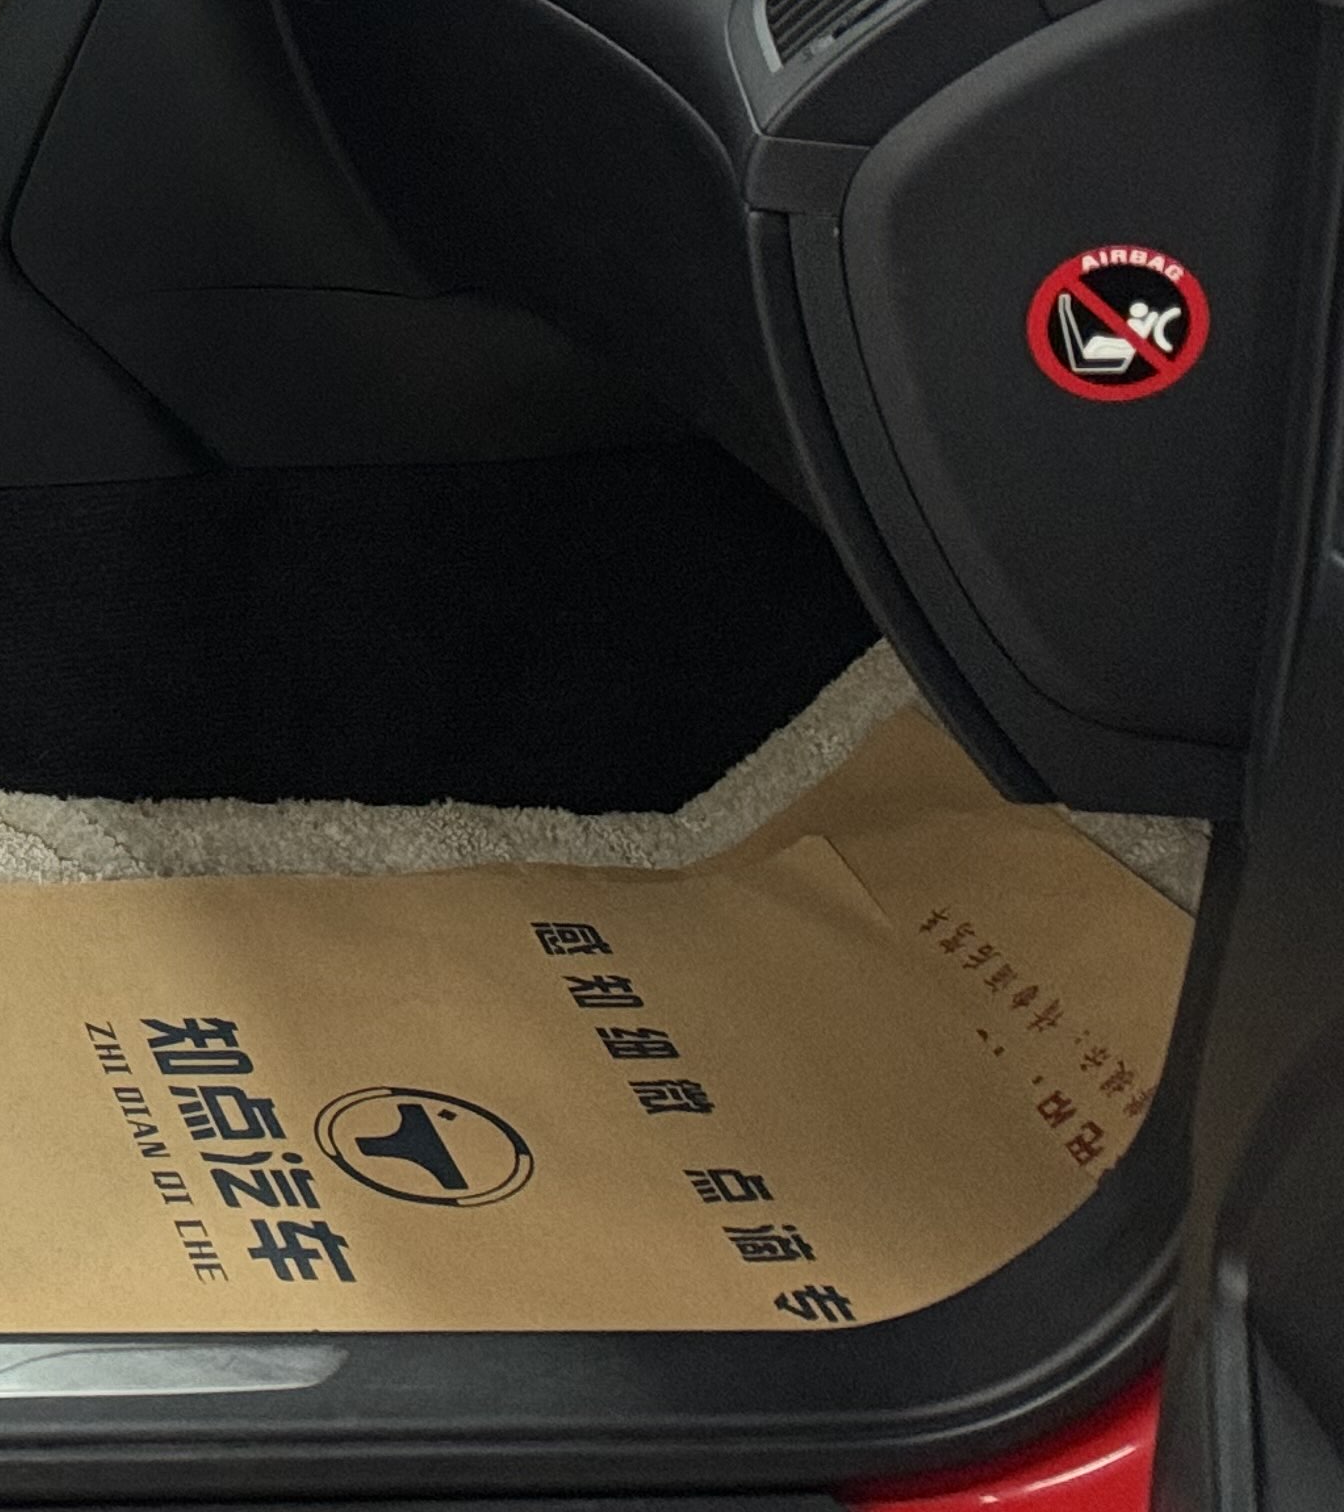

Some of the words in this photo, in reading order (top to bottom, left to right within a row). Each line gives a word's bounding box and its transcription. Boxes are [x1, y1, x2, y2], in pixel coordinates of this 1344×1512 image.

[1080, 248, 1186, 282] AIRBAG
[84, 1019, 134, 1077] ZHI
[113, 1085, 172, 1161] DIAN
[149, 1171, 193, 1205] QI
[174, 1218, 229, 1284] CHE
[139, 1017, 358, 1285] 知点汽车
[528, 920, 715, 1116] 感知细微
[683, 1167, 859, 1324] 点滴专
